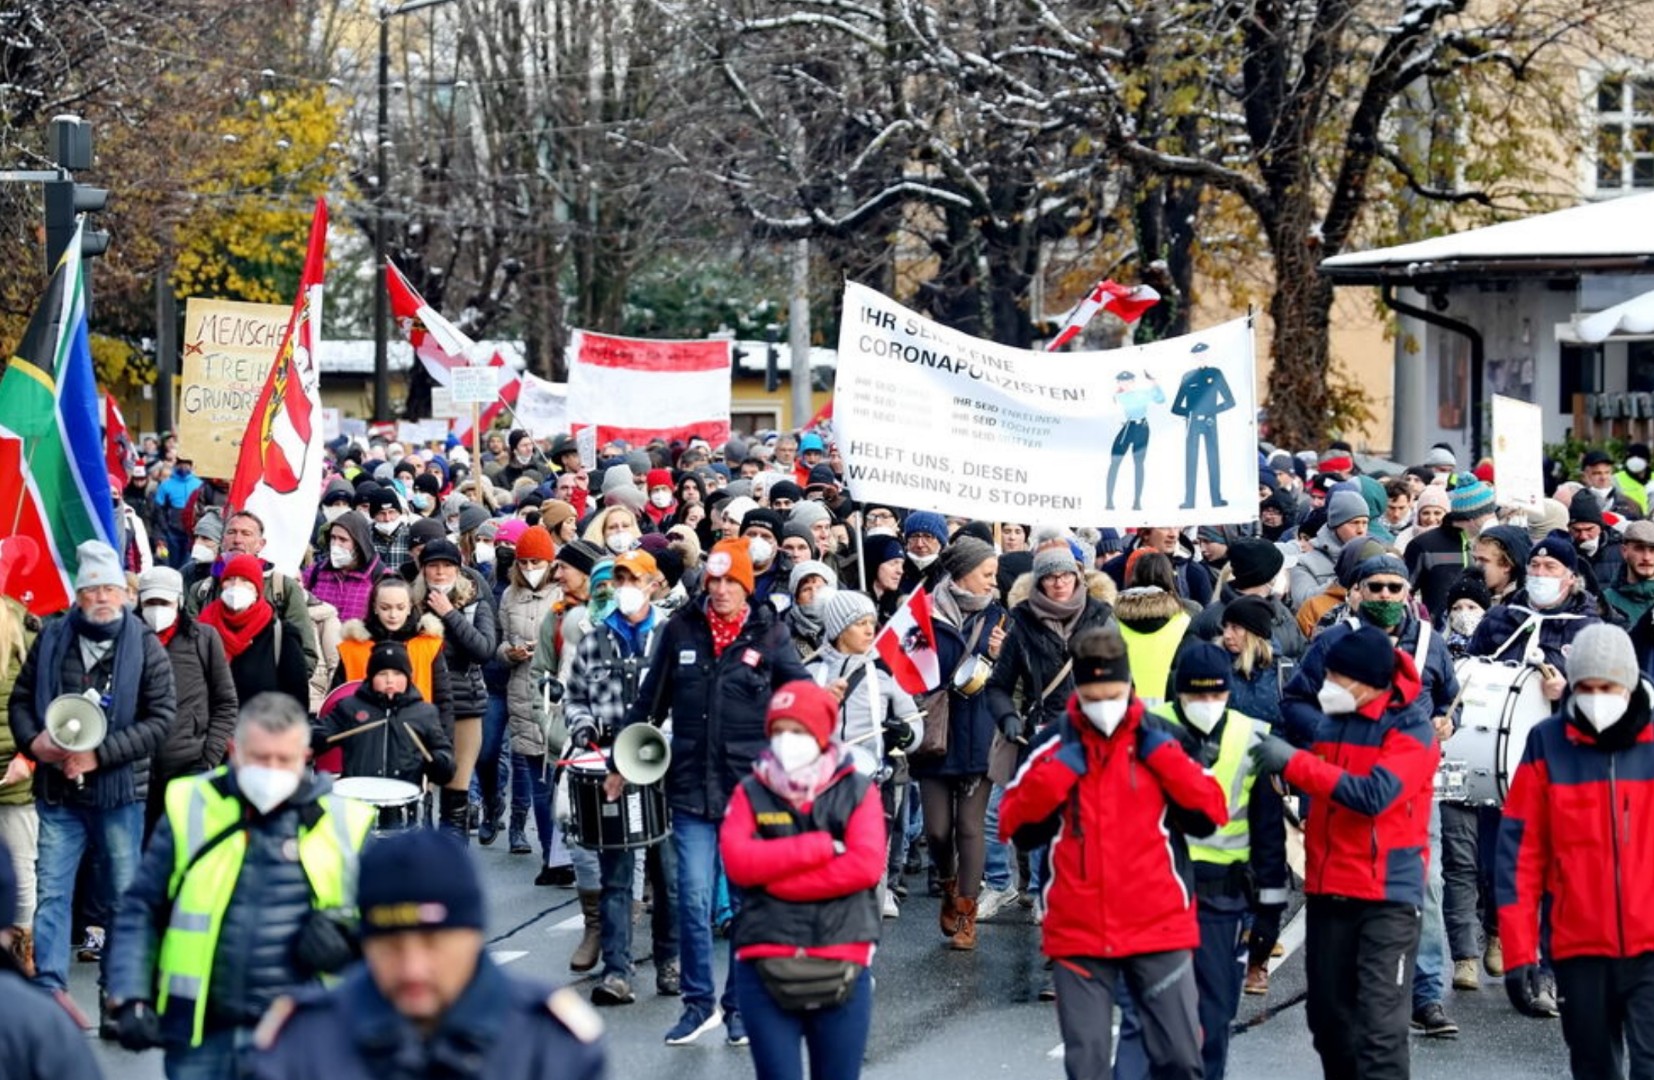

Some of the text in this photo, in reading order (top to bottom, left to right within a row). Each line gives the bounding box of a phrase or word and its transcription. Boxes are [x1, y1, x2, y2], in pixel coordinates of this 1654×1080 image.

[861, 306, 897, 331] IHR
[953, 396, 971, 407] IHR
[974, 401, 998, 412] SEID
[973, 415, 996, 426] SEID
[850, 440, 905, 462] HELFT
[963, 461, 1028, 484] DIESEN
[849, 464, 1082, 510] WAHNSINN ZU STOPPEN!
